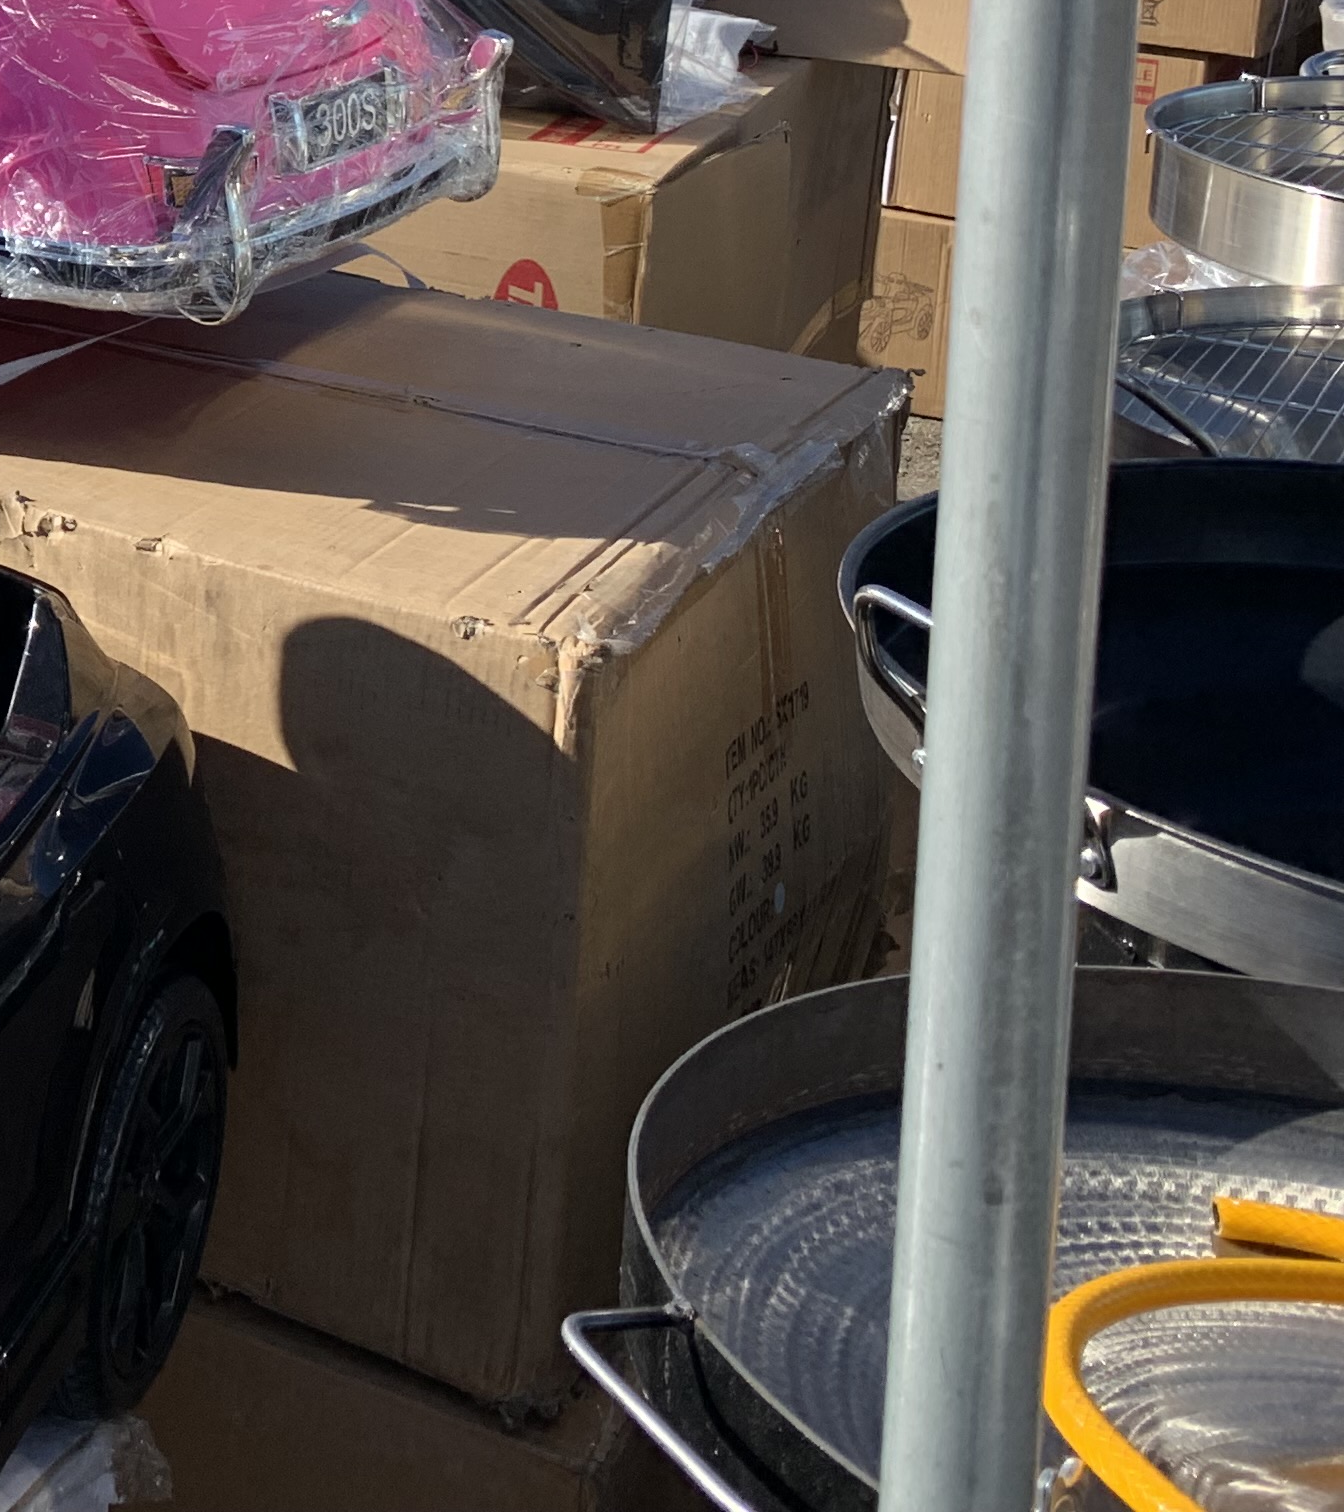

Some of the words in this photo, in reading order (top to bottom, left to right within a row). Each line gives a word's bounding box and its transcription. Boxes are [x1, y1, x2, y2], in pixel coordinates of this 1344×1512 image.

[316, 90, 376, 147] 300S
[790, 769, 808, 808] KG
[793, 813, 811, 850] KG
